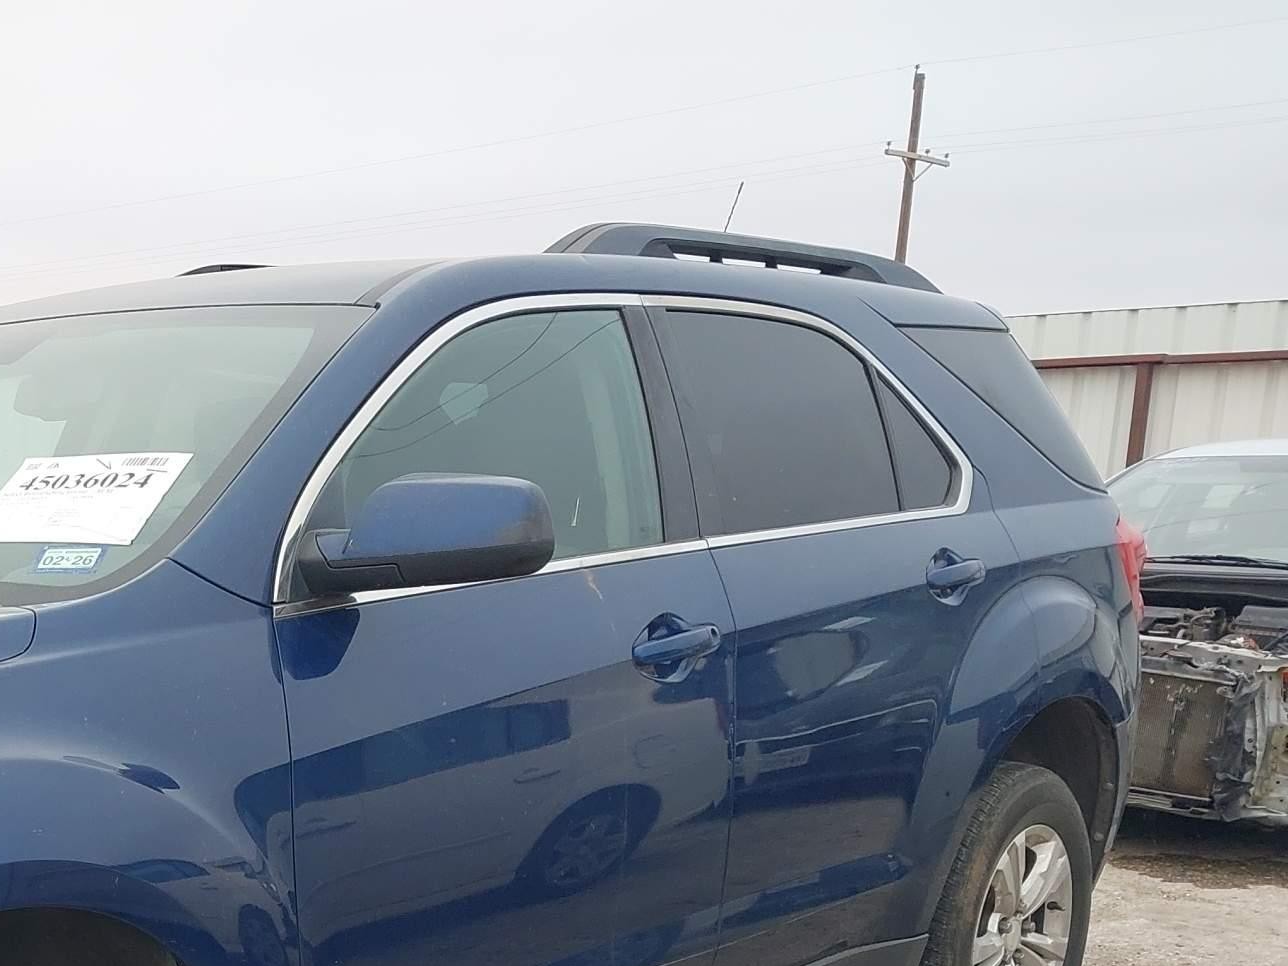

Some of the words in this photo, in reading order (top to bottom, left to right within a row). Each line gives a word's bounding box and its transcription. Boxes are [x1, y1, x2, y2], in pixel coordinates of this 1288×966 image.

[19, 472, 155, 490] 45036024
[42, 555, 65, 566] 02
[72, 555, 95, 566] 26
